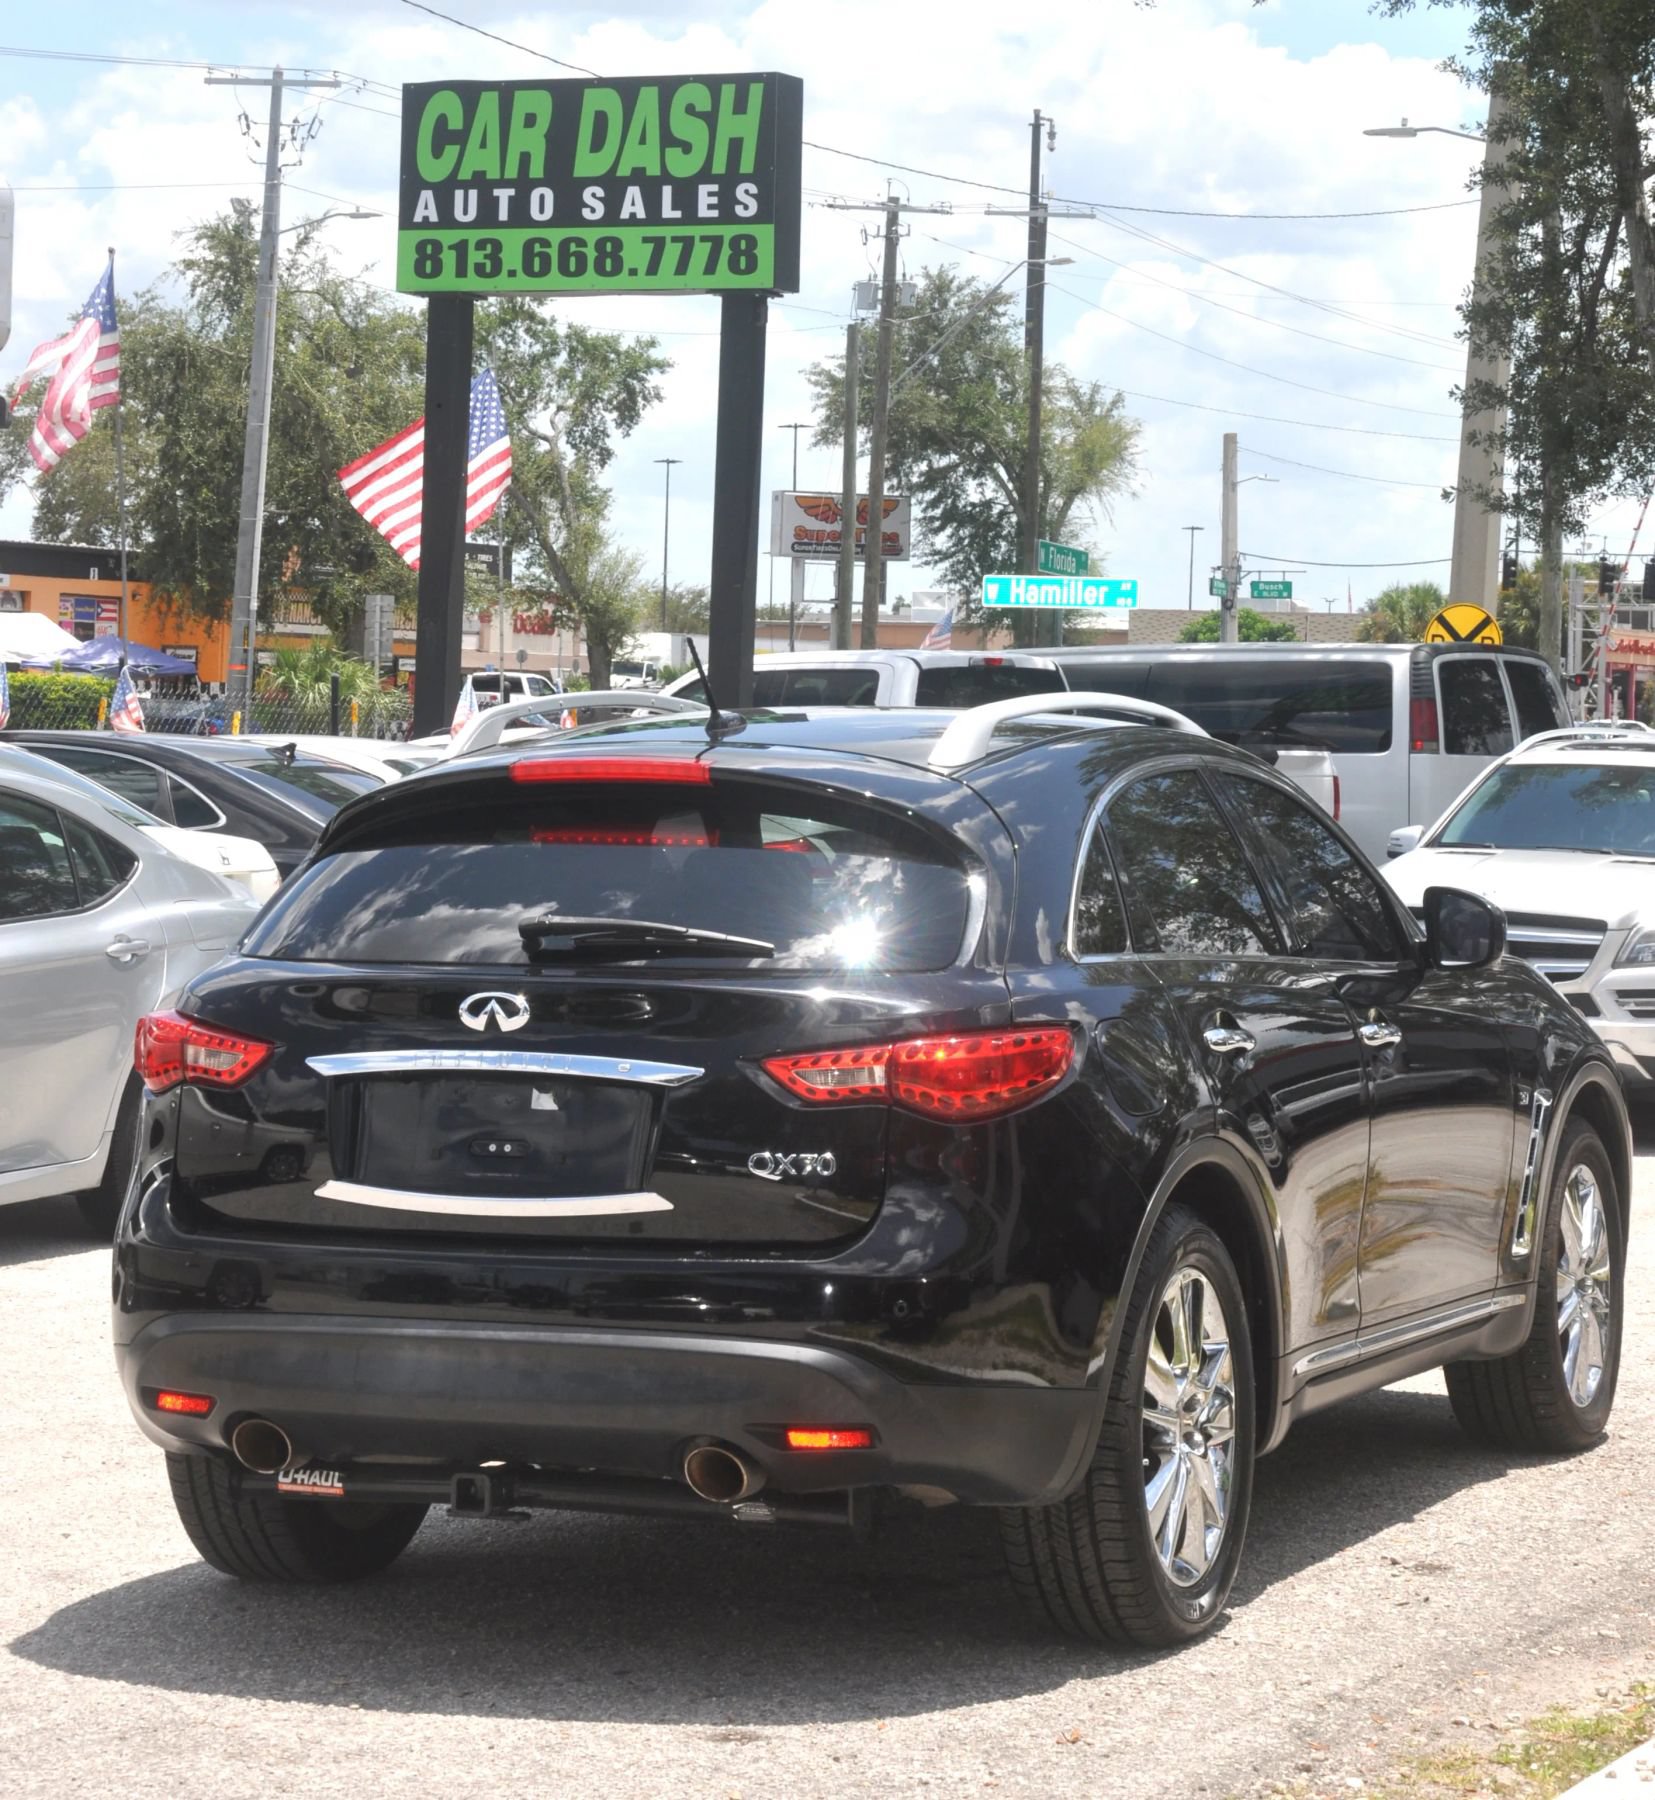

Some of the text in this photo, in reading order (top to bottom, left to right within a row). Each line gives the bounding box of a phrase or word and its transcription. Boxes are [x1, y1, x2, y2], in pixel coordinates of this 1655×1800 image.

[416, 82, 765, 183] CAR DASH
[413, 182, 760, 223] AUTO SALES
[413, 233, 759, 279] 813.668.7778
[1048, 546, 1076, 574] Florida
[1009, 578, 1109, 606] Hamiller
[748, 1151, 836, 1181] QX70
[278, 1468, 343, 1488] U-HAUL
